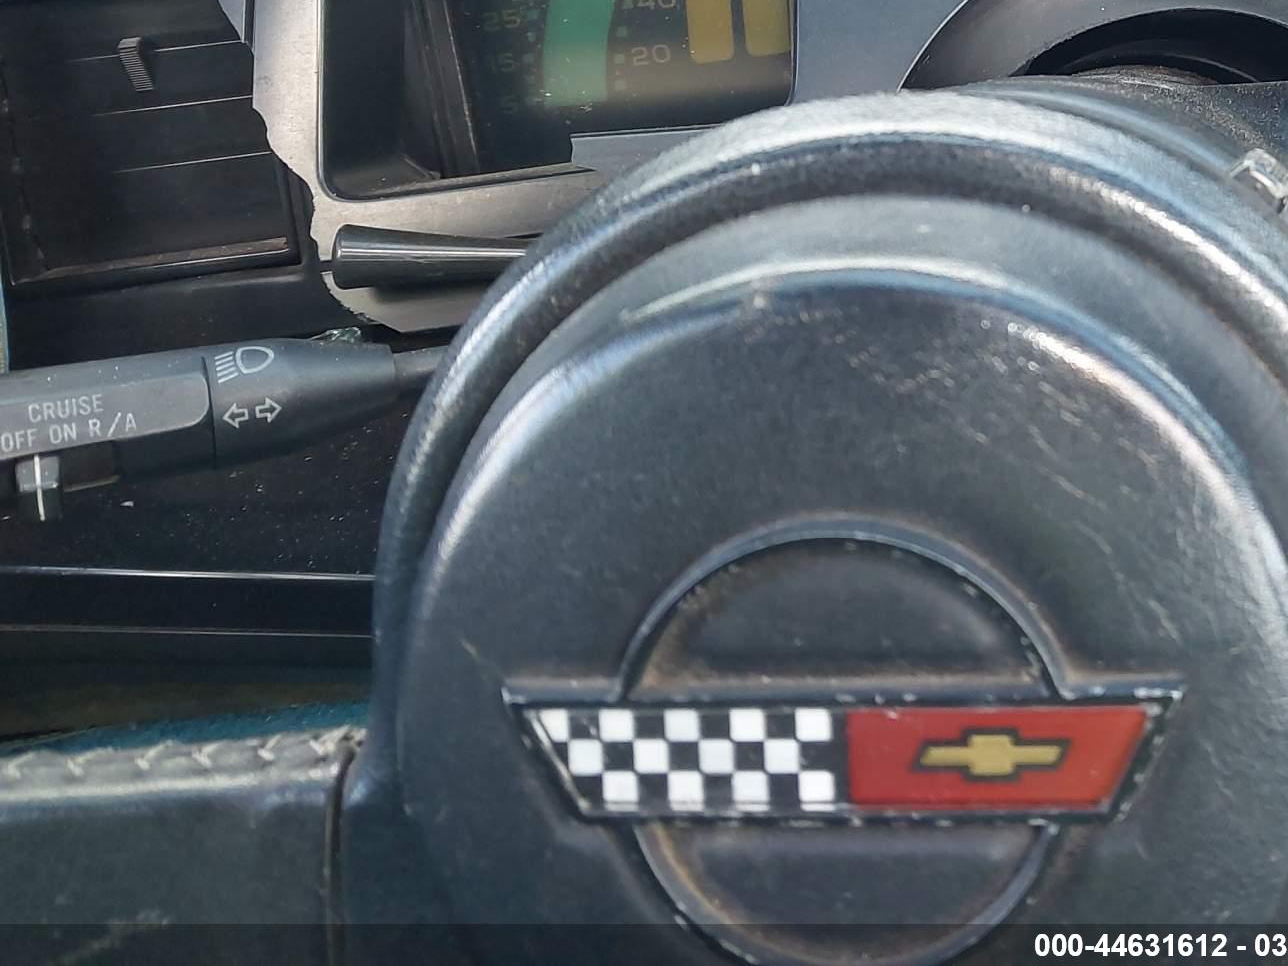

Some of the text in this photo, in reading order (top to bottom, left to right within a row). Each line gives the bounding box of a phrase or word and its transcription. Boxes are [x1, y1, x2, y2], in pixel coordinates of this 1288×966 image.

[482, 8, 522, 33] 25
[630, 43, 671, 67] 20
[28, 393, 104, 423] CRUISE
[1, 428, 38, 453] OFF
[49, 422, 77, 445] ON
